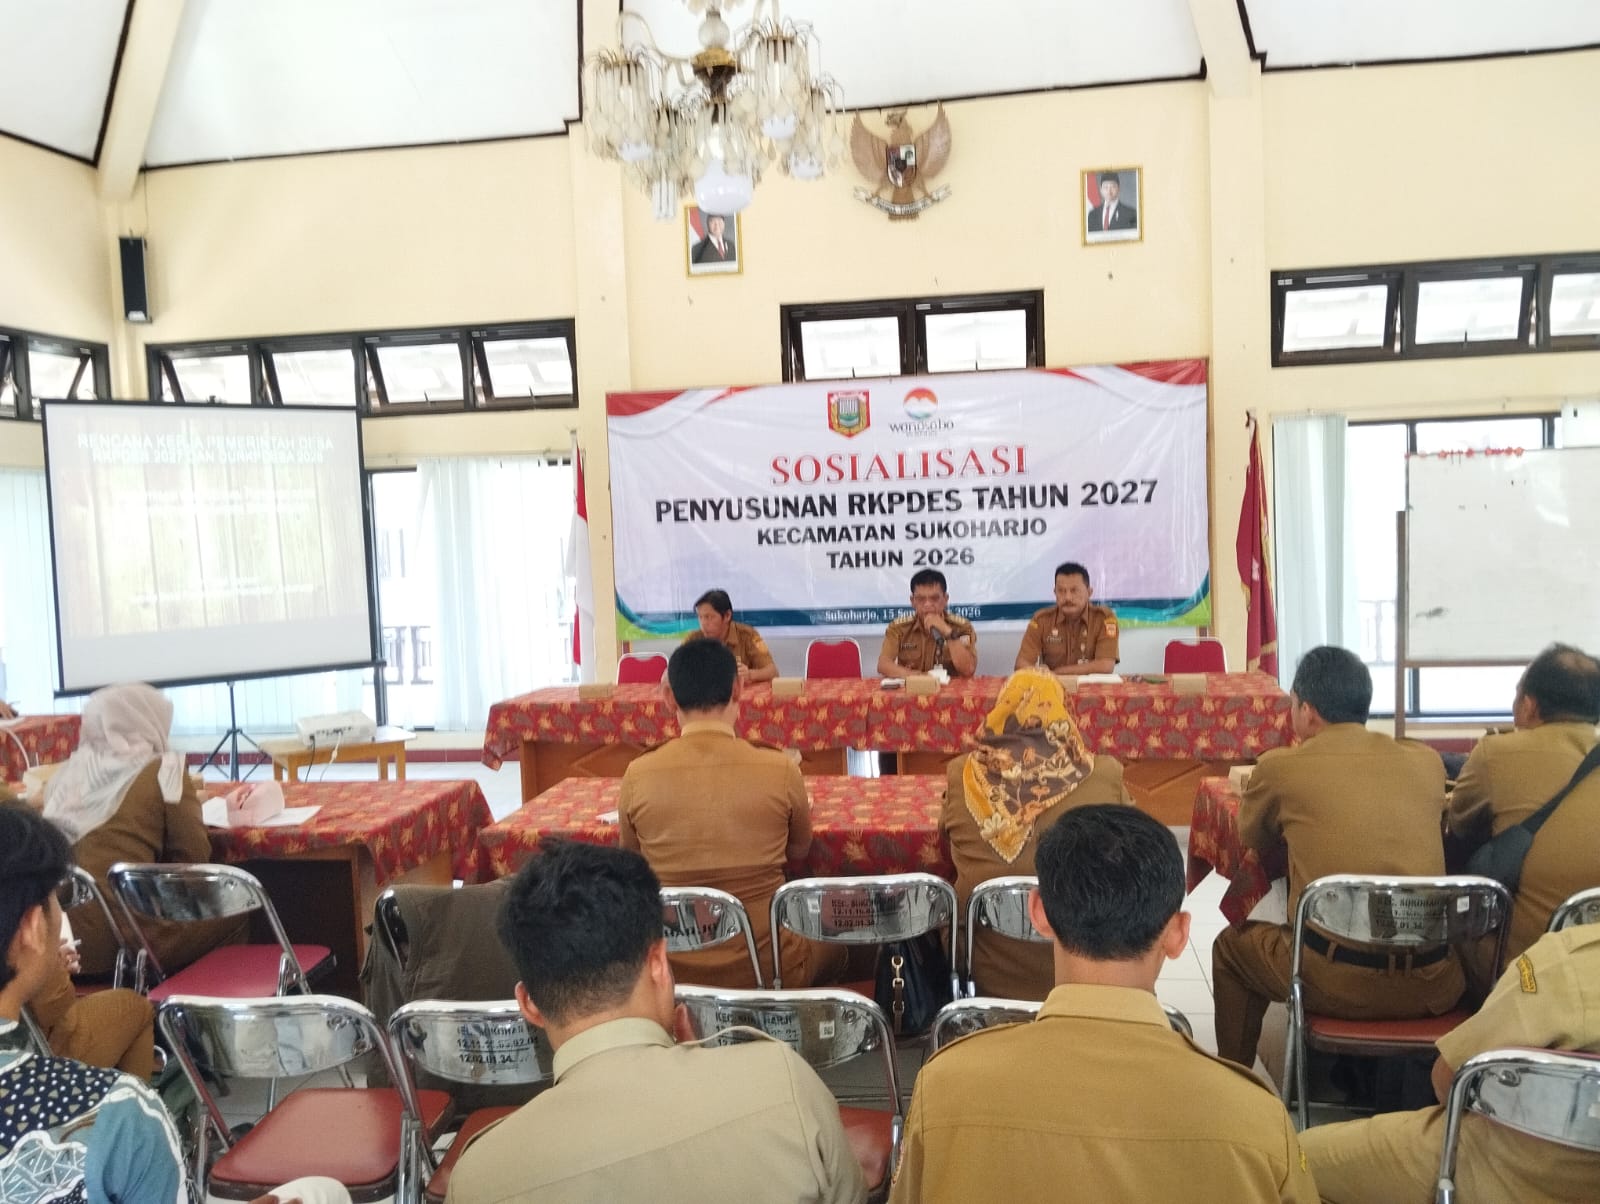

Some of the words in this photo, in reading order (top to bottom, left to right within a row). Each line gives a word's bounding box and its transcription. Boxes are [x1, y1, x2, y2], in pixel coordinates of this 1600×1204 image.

[772, 445, 1028, 485] SOSIALISASI
[656, 493, 839, 523] PENYUSUNAN
[847, 488, 963, 516] RKPDES
[972, 485, 1070, 510] TAHUN
[1081, 480, 1158, 506] 2027
[757, 523, 896, 546] KECAMATAN
[904, 518, 1047, 542] SUKOHARJO
[826, 549, 904, 570] TAHUN
[913, 547, 975, 567] 2026
[825, 609, 880, 623] Sukoharjo,
[883, 608, 895, 619] 15
